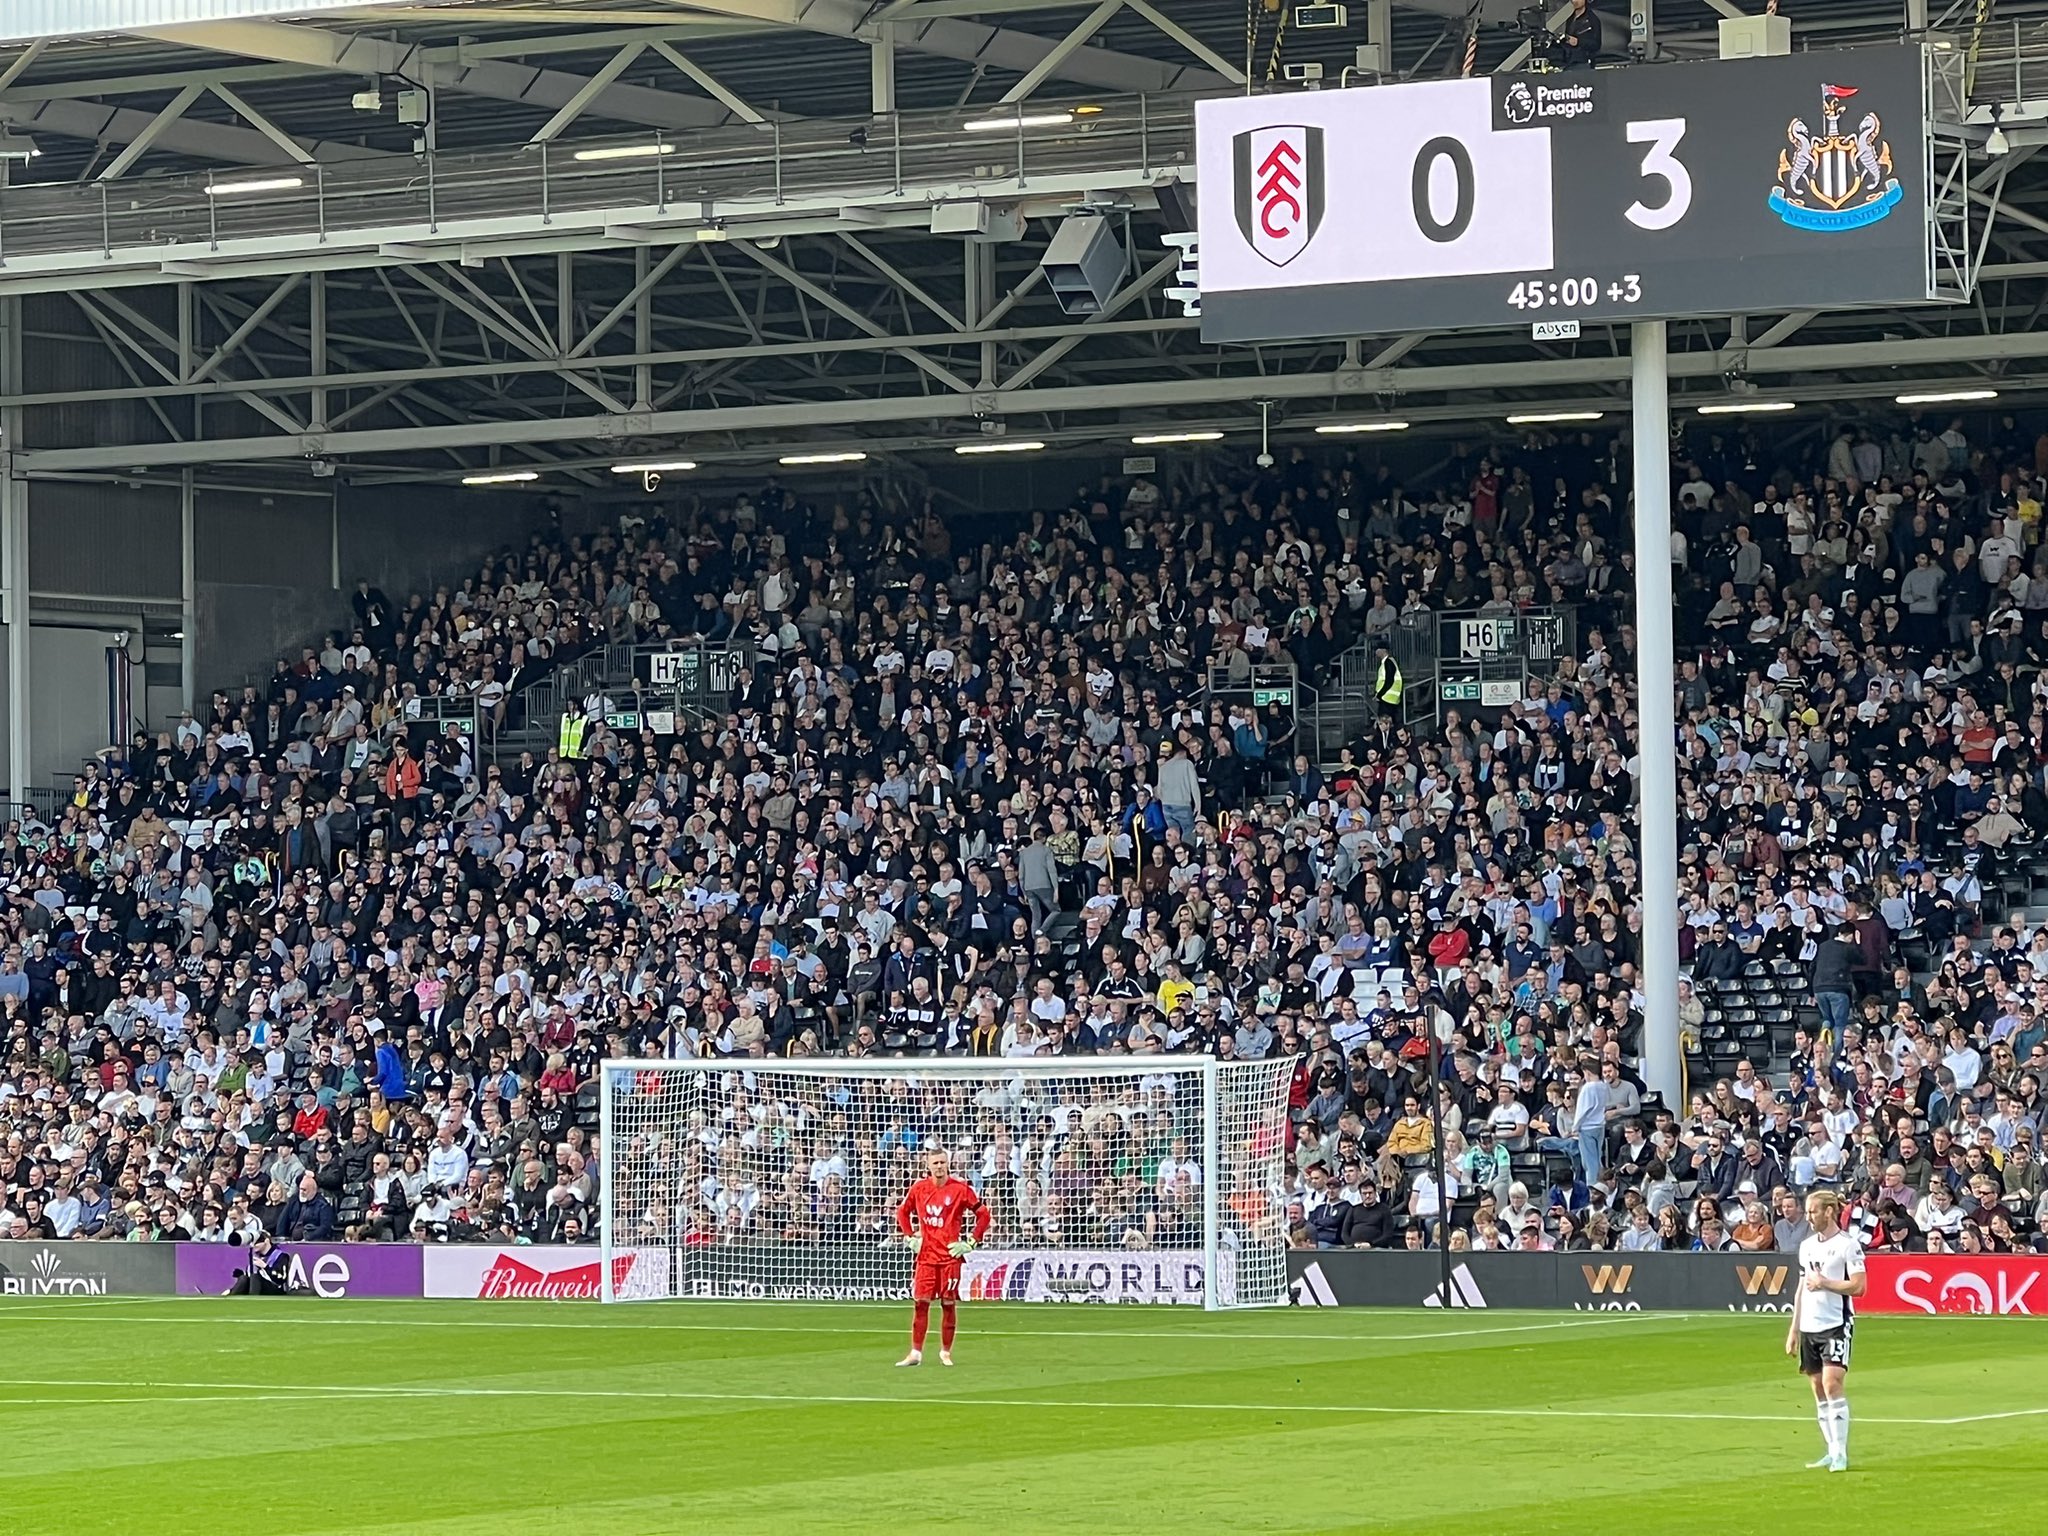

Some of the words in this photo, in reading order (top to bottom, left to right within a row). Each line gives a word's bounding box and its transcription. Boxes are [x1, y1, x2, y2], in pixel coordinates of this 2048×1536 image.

[1537, 84, 1593, 101] Premier
[1537, 100, 1594, 118] League
[1624, 118, 1692, 230] 3
[1257, 140, 1301, 238] FFC
[1412, 136, 1475, 243] 0
[1507, 277, 1598, 309] 45:00
[1606, 274, 1642, 302] +3
[1467, 623, 1493, 647] H6
[657, 657, 680, 680] H7
[947, 1279, 958, 1290] 17
[1044, 1262, 1205, 1293] WORLD
[1829, 1339, 1844, 1356] 13
